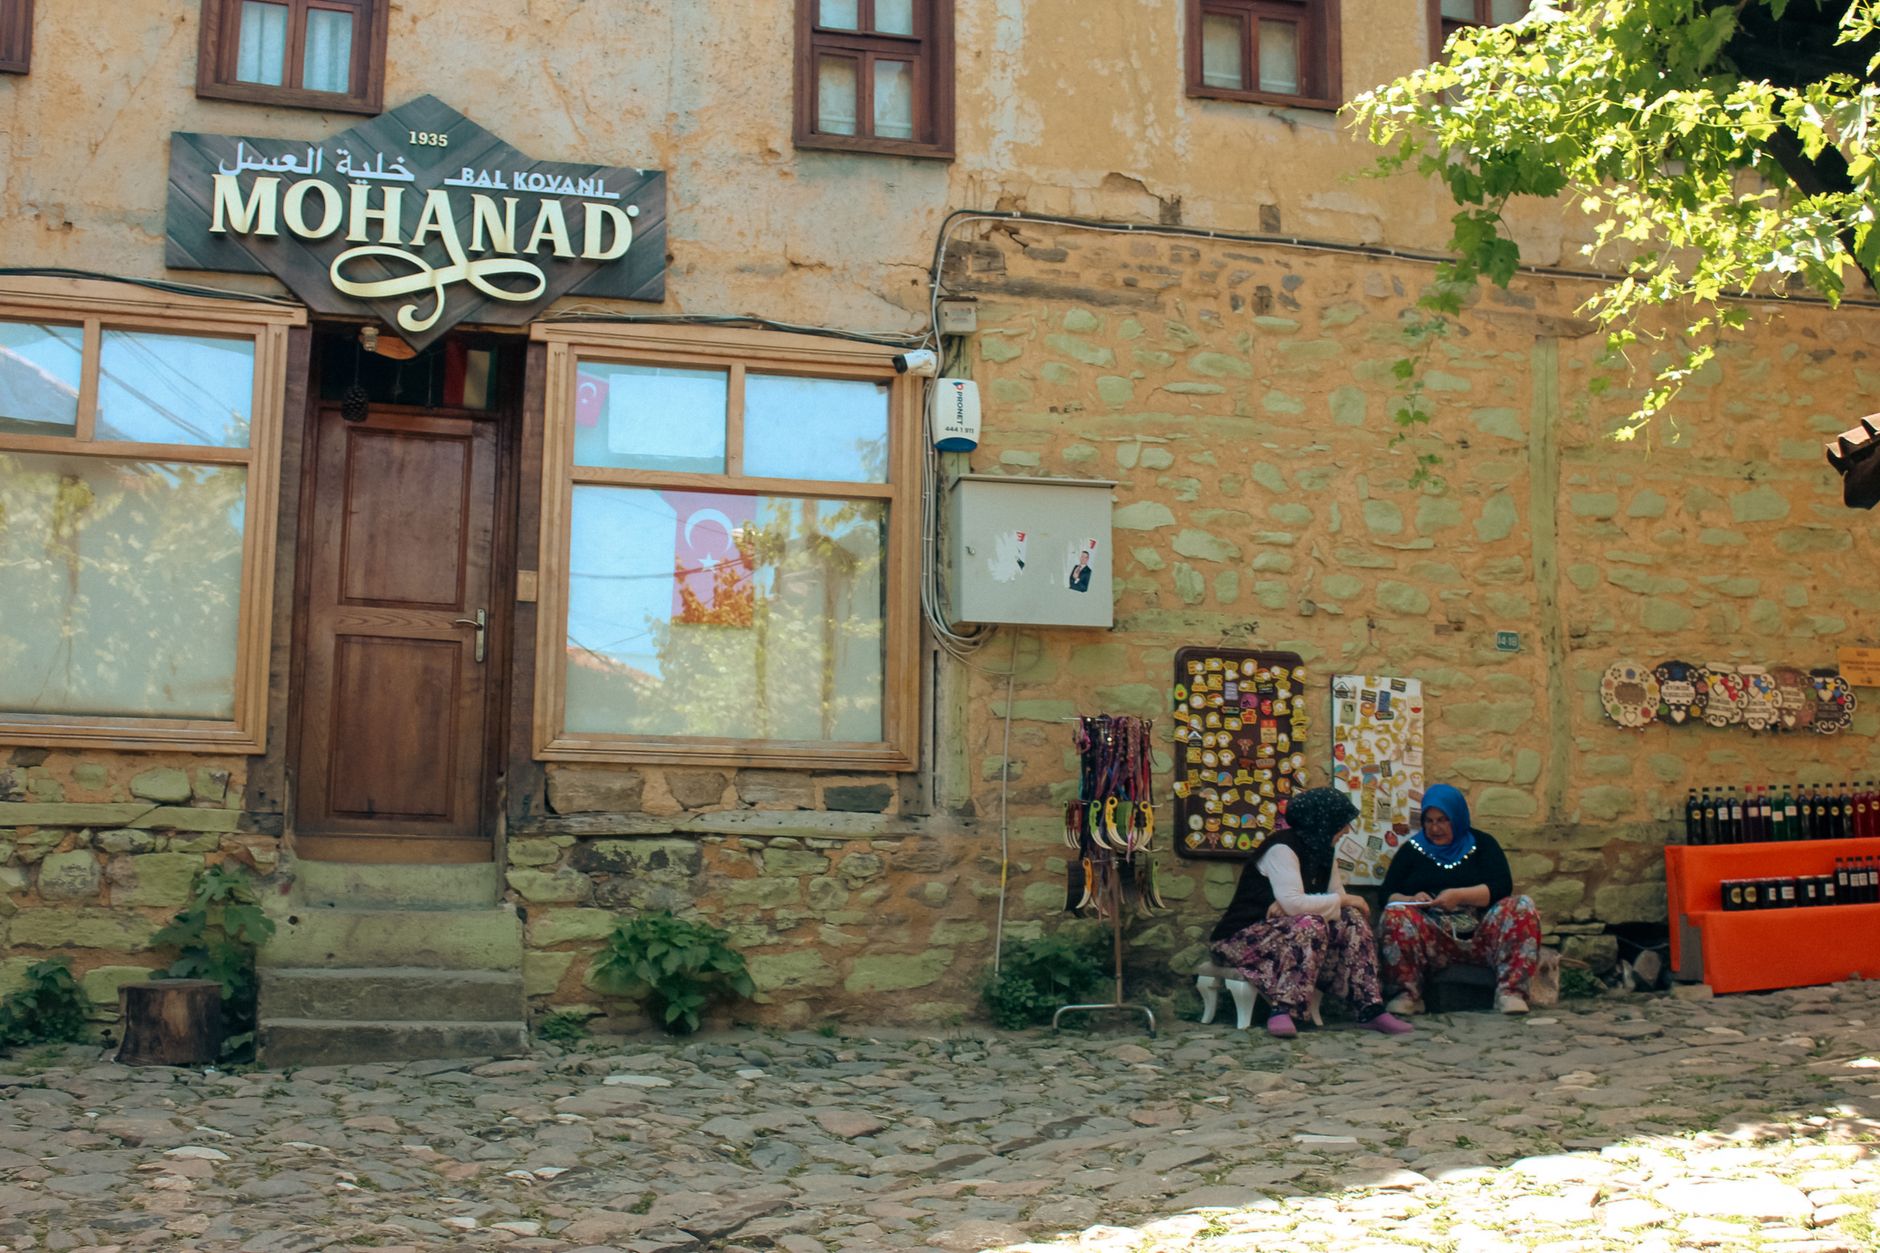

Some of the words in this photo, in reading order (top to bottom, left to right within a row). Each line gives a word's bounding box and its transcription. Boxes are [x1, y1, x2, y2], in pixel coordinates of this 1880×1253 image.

[409, 131, 448, 147] 1935
[218, 141, 323, 176] العسل
[336, 148, 415, 184] خلية
[445, 167, 508, 189] BAL
[513, 171, 619, 199] KOVANI
[209, 174, 633, 261] MOHANAD
[956, 391, 964, 426] PRONET
